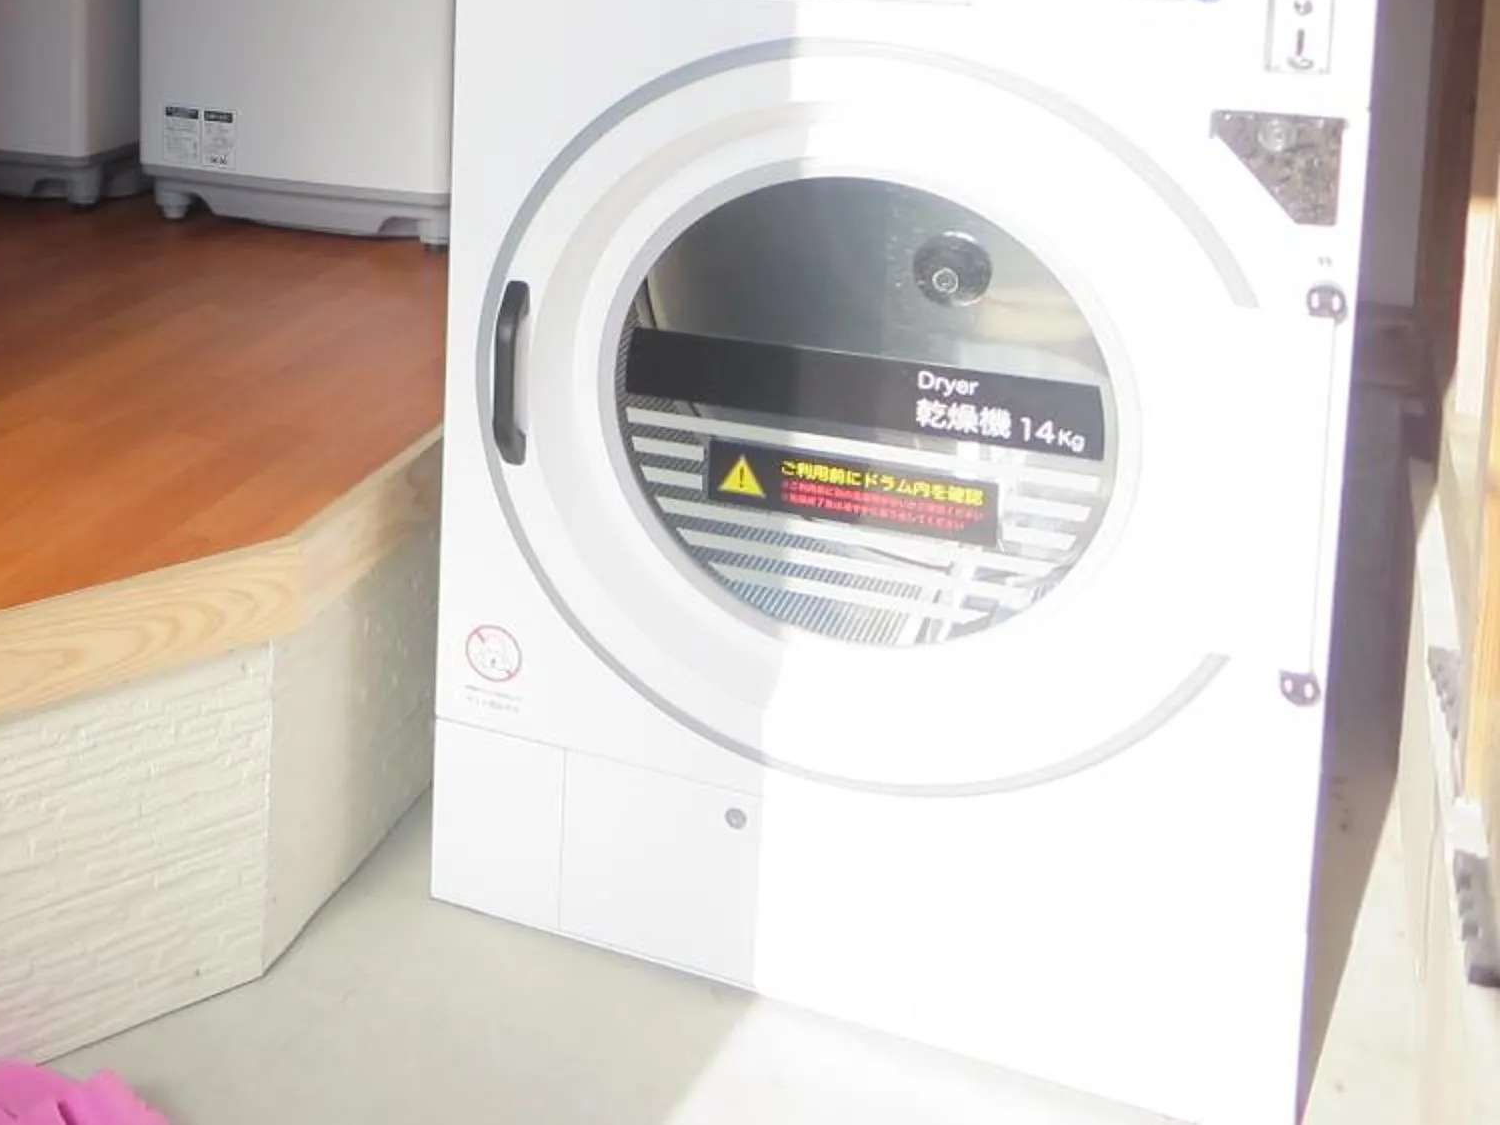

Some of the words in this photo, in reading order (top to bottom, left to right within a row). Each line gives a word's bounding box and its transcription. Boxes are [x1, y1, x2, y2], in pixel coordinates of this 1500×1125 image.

[917, 370, 980, 397] Dryer
[916, 398, 1012, 440] 乾燥機
[781, 459, 985, 507] ご利用前にドラム内を確認
